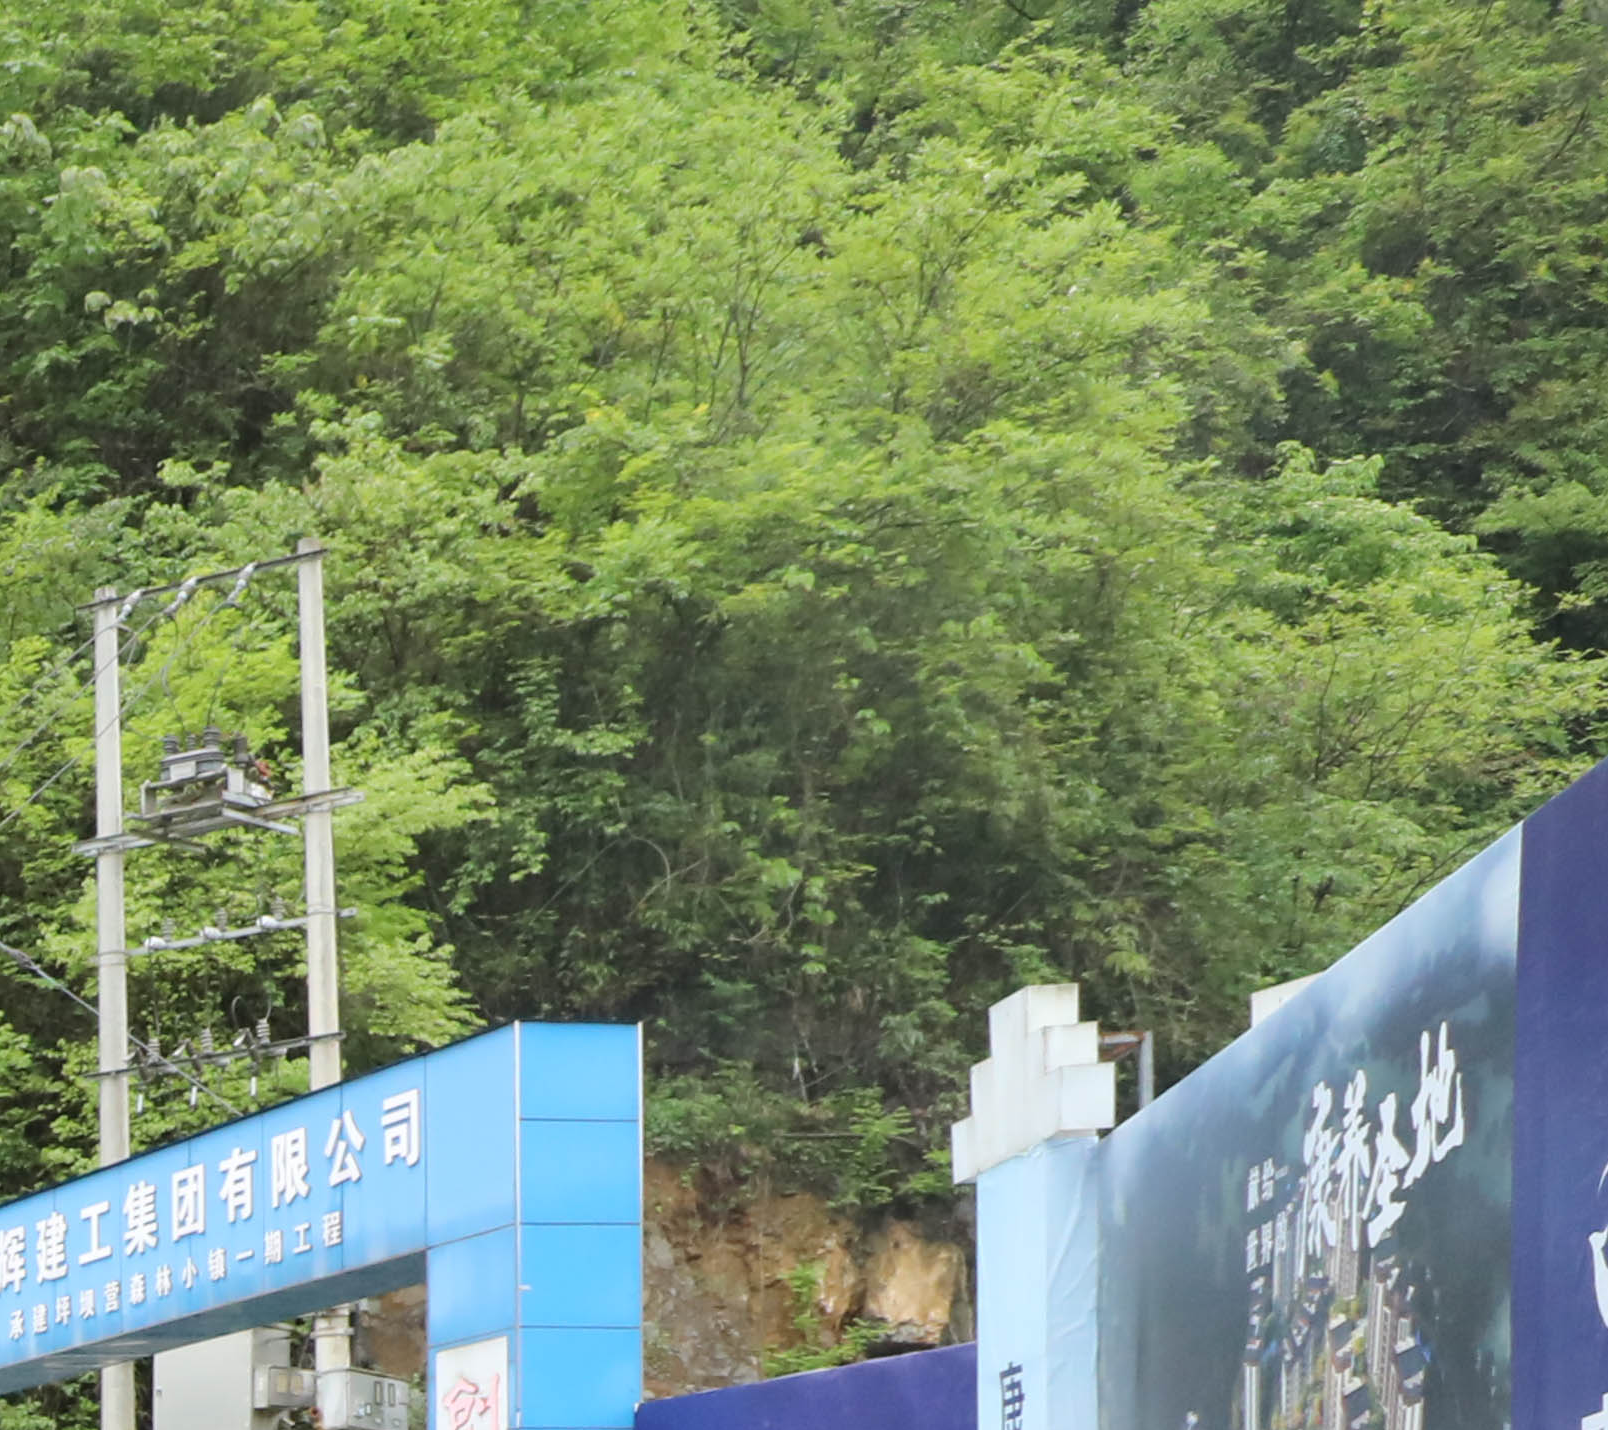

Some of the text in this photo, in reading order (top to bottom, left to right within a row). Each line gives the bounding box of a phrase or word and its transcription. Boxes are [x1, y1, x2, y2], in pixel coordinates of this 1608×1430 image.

[8, 1209, 344, 1342] 承建坪坝营森林小镇一期工程
